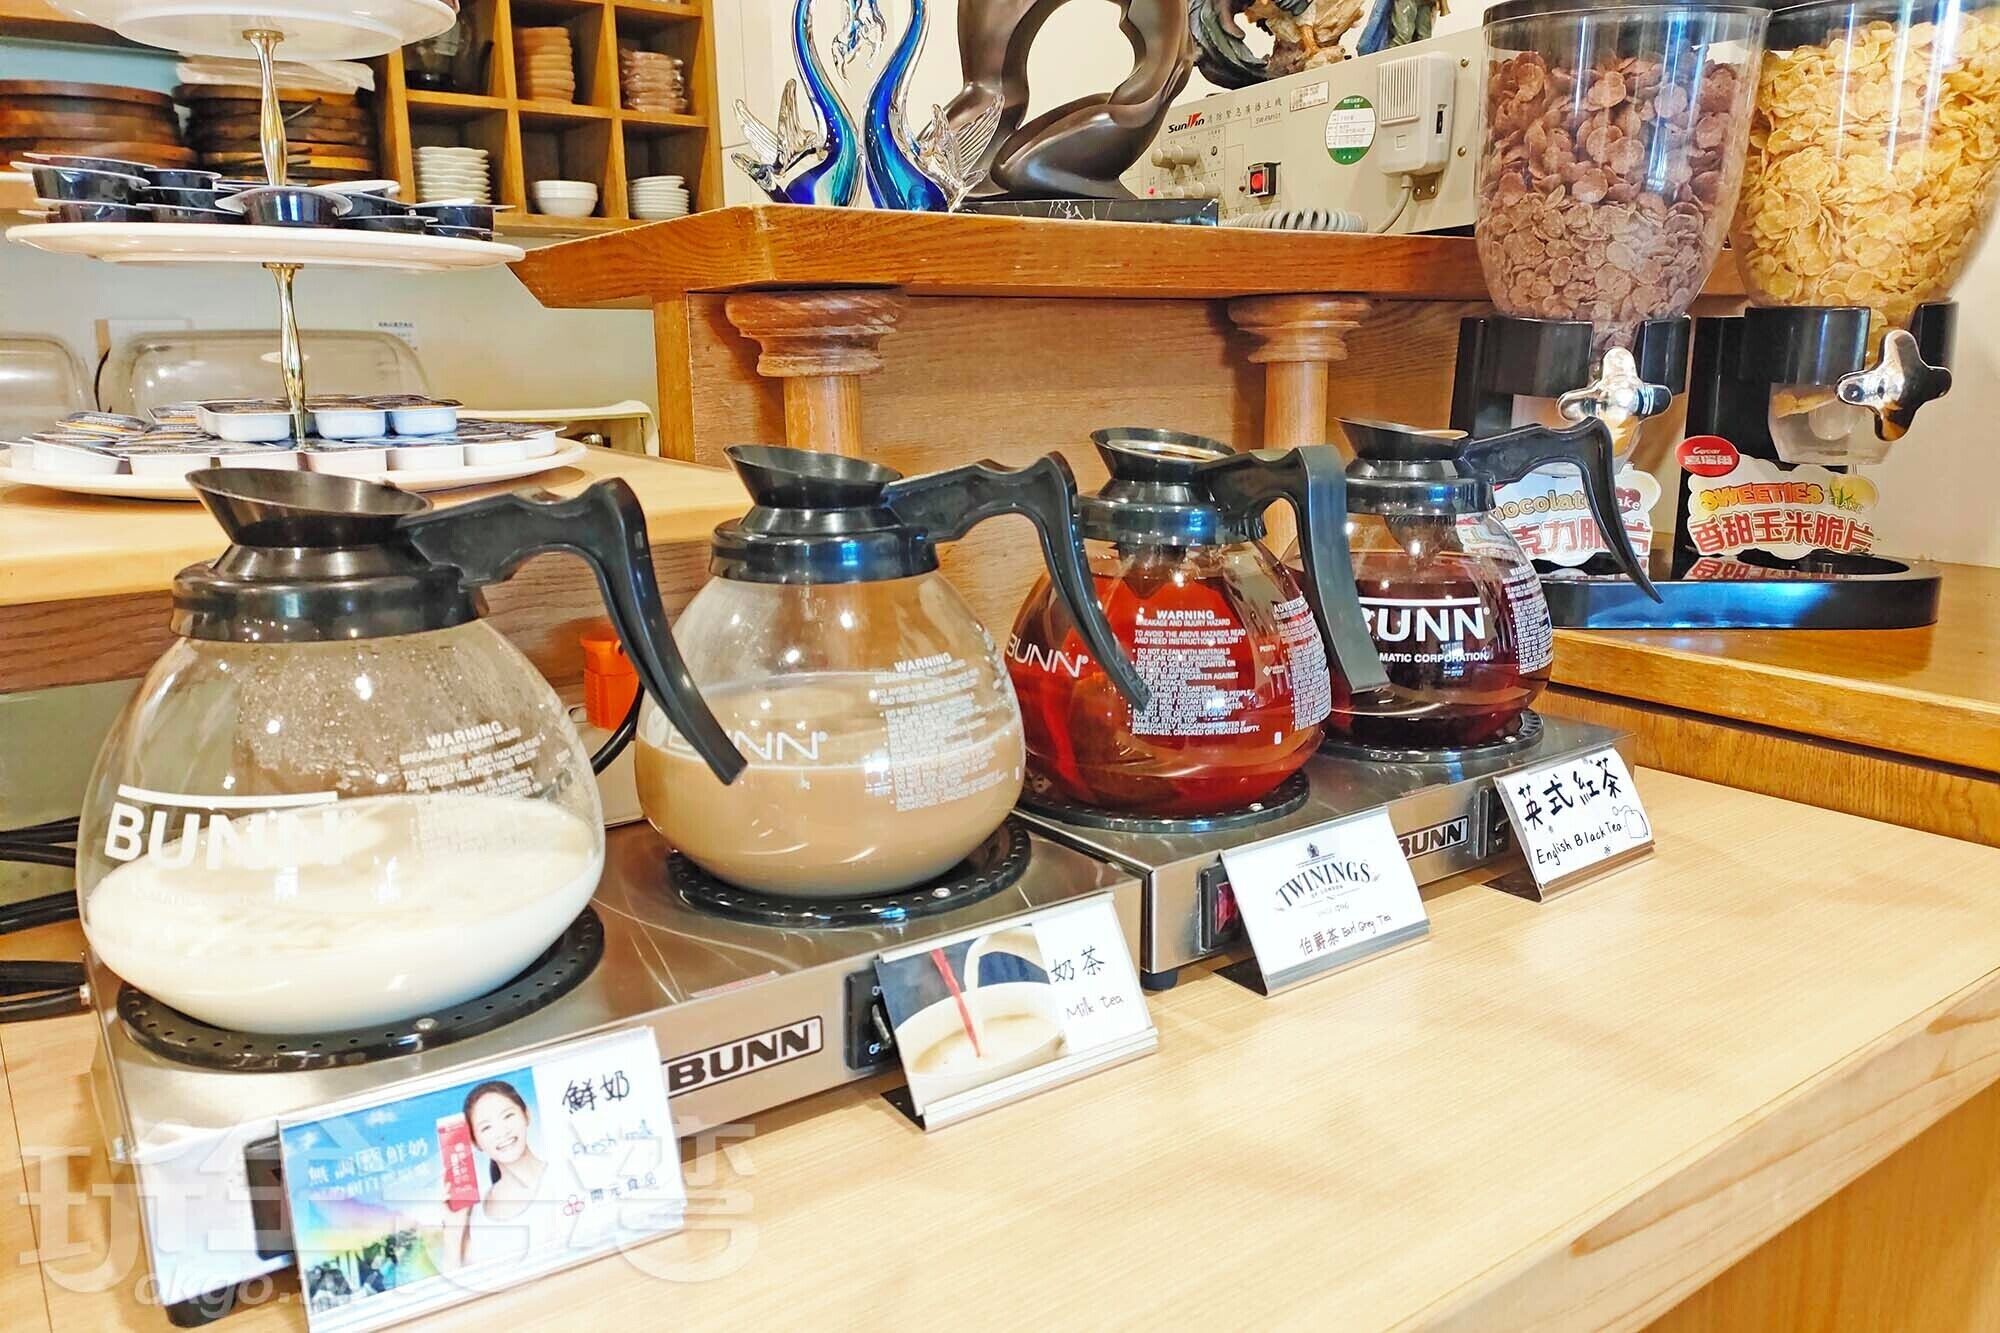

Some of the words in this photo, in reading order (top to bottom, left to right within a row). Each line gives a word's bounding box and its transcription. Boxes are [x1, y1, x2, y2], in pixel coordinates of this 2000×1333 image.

[1700, 482, 1824, 511] SWEETIES
[1690, 511, 1874, 553] 香甜玉米脆片
[1156, 610, 1214, 620] WARNING
[1206, 618, 1230, 626] HAZARD
[1134, 637, 1149, 645] AND
[1135, 629, 1143, 637] TO
[1144, 630, 1164, 638] AVOID
[1165, 630, 1178, 638] THE
[1179, 630, 1199, 638] ABOVE
[1230, 628, 1246, 636] READ
[894, 652, 953, 672] WARNING
[1138, 647, 1146, 655] DO
[1147, 648, 1160, 656] NOT
[1181, 648, 1198, 656] WITH
[1198, 647, 1231, 656] MATERIALS
[1414, 651, 1490, 663] CORPORATION
[1213, 671, 1239, 680] AGAINST
[426, 720, 503, 749] WARNING
[403, 770, 417, 782] TO
[1536, 838, 1572, 866] English
[1574, 830, 1606, 848] Black
[1604, 820, 1622, 834] Tea
[1275, 860, 1371, 907] TWININGS
[1300, 928, 1340, 956] 伯爵茶
[1341, 920, 1357, 938] Earl
[1358, 920, 1377, 935] Grey
[1376, 913, 1392, 926] Tea
[1050, 945, 1105, 983] 奶茶
[667, 1023, 809, 1093] BUNN
[561, 1070, 630, 1115] 鮮奶
